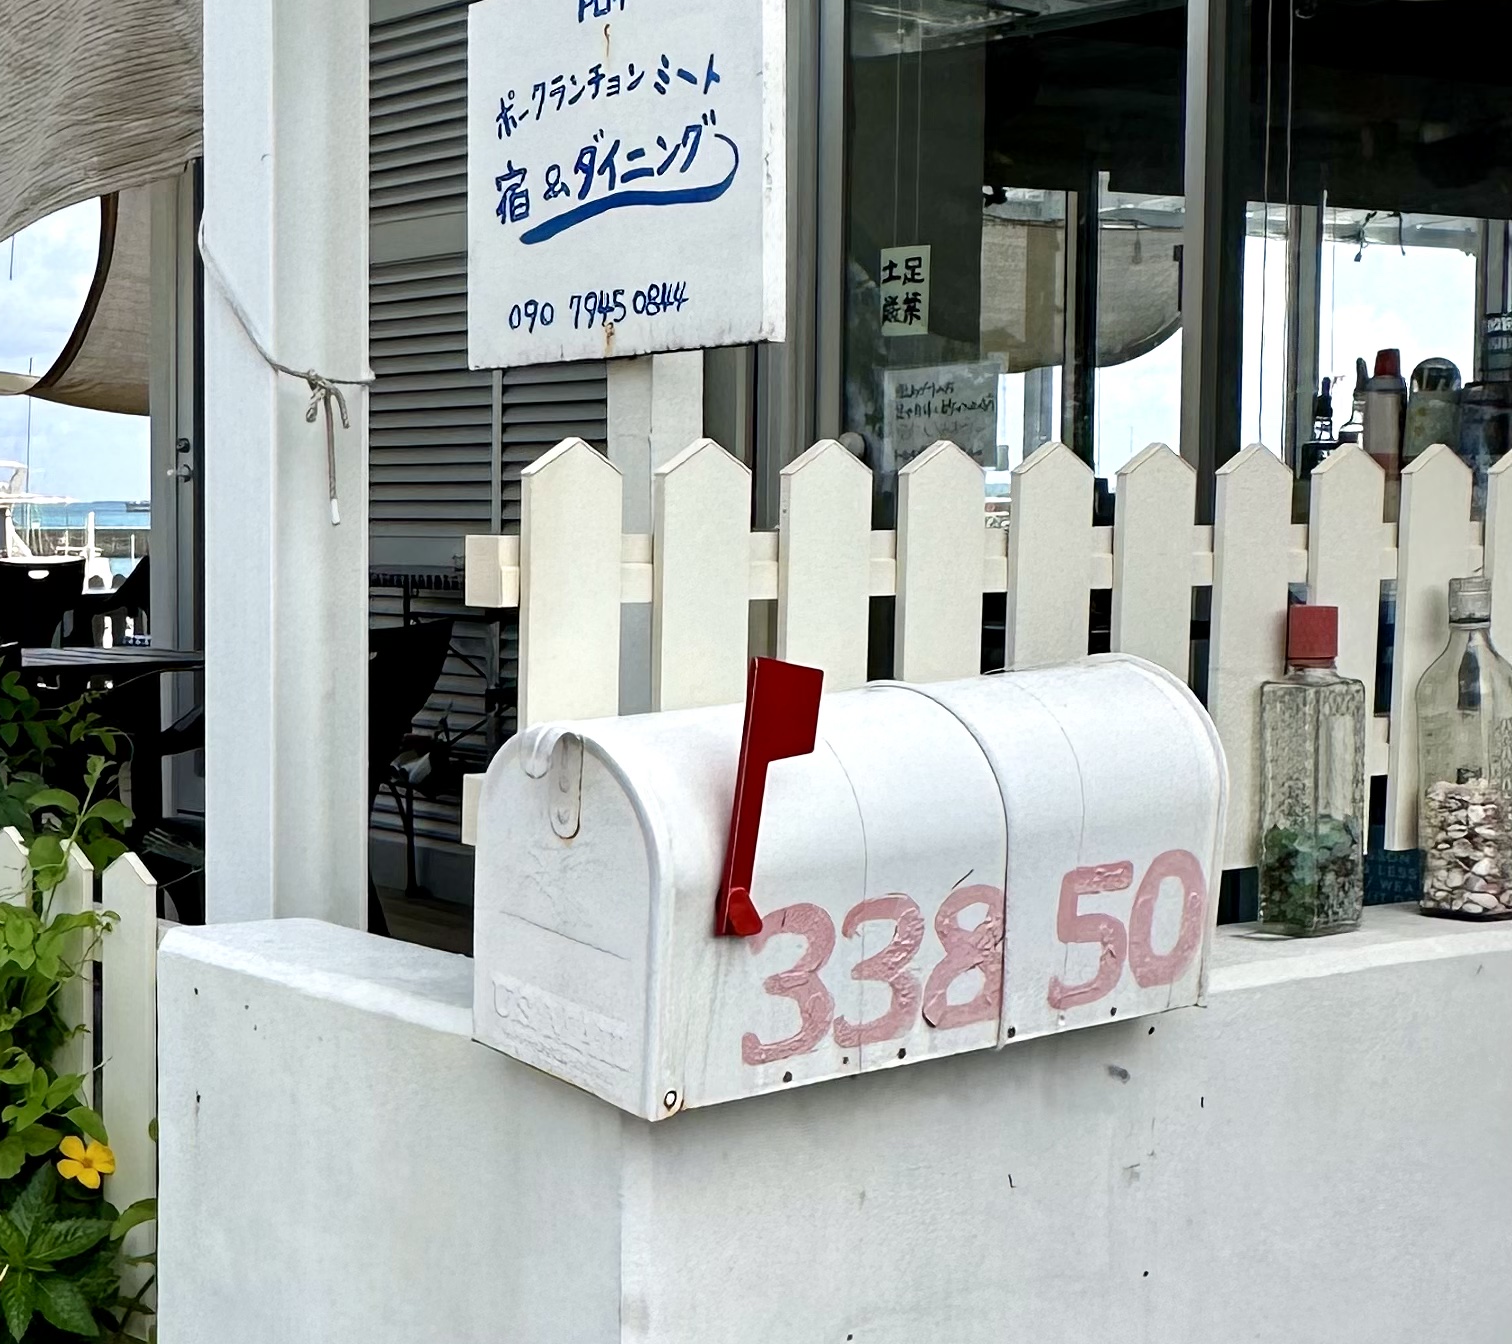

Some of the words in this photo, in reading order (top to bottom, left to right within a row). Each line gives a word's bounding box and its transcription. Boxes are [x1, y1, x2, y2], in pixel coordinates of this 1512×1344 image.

[881, 256, 925, 286] 土足
[508, 299, 555, 334] 090
[741, 884, 1005, 1067] 338
[1047, 848, 1209, 1011] 50
